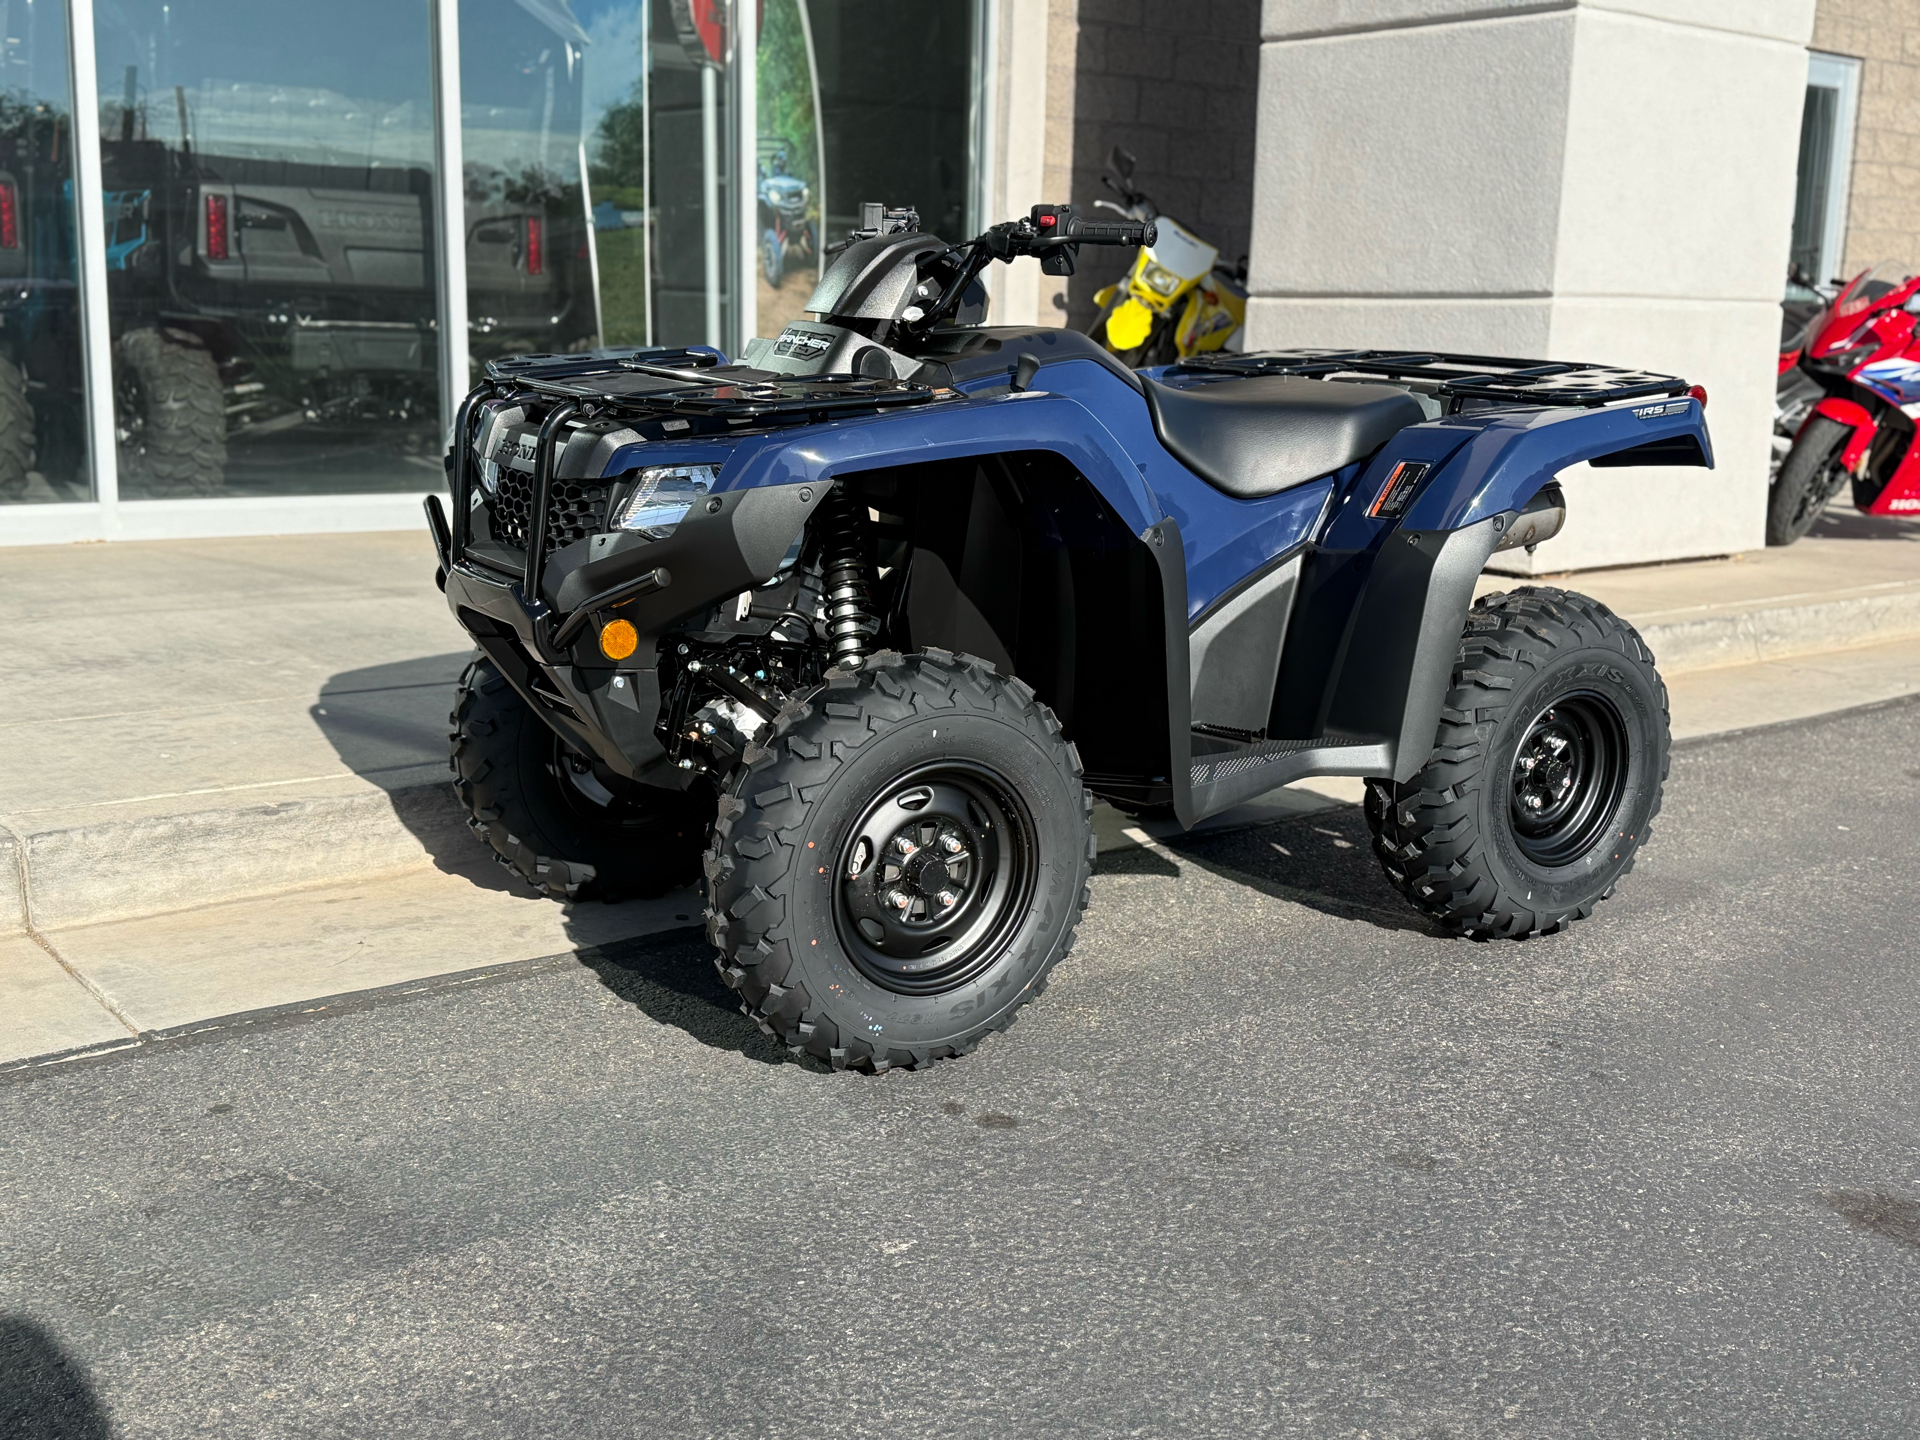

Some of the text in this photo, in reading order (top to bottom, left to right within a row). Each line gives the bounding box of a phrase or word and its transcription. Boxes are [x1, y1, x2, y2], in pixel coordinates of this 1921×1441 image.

[1639, 405, 1665, 416] IRS
[497, 439, 537, 461] HON
[1888, 499, 1921, 510] HO
[1513, 663, 1626, 740] MAXXIS
[948, 857, 1066, 1022] MAXXIS
